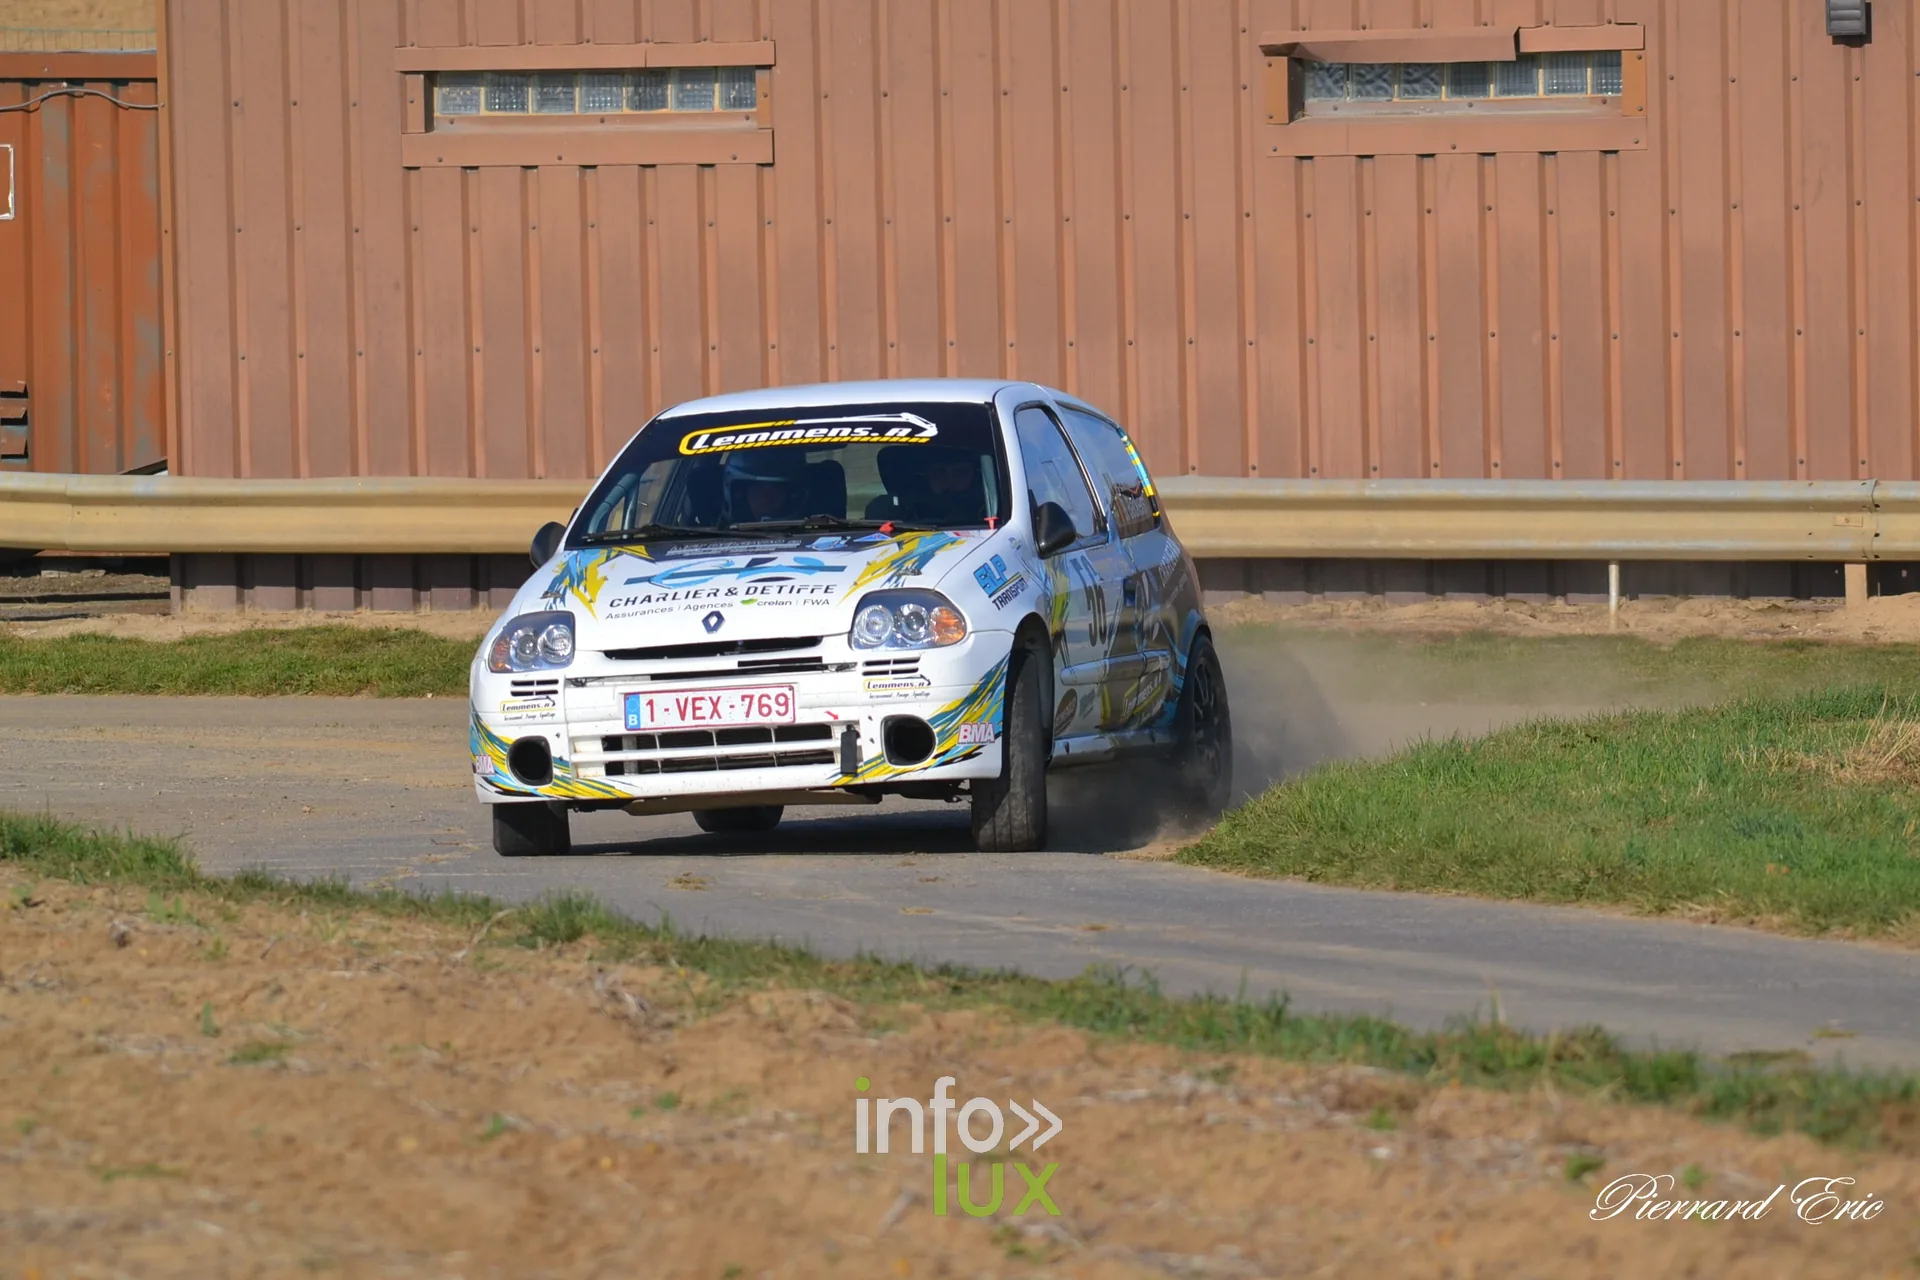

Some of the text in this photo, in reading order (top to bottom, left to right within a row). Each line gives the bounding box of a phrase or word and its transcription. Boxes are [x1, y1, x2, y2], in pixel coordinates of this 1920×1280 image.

[609, 584, 838, 608] CHARLIER & DETIFFE
[992, 577, 1030, 611] TRANSPORT
[605, 598, 831, 620] Assurances Agences crelan FWA
[645, 692, 790, 723] 1-VEX-769
[628, 714, 639, 726] B
[959, 723, 995, 743] BMA
